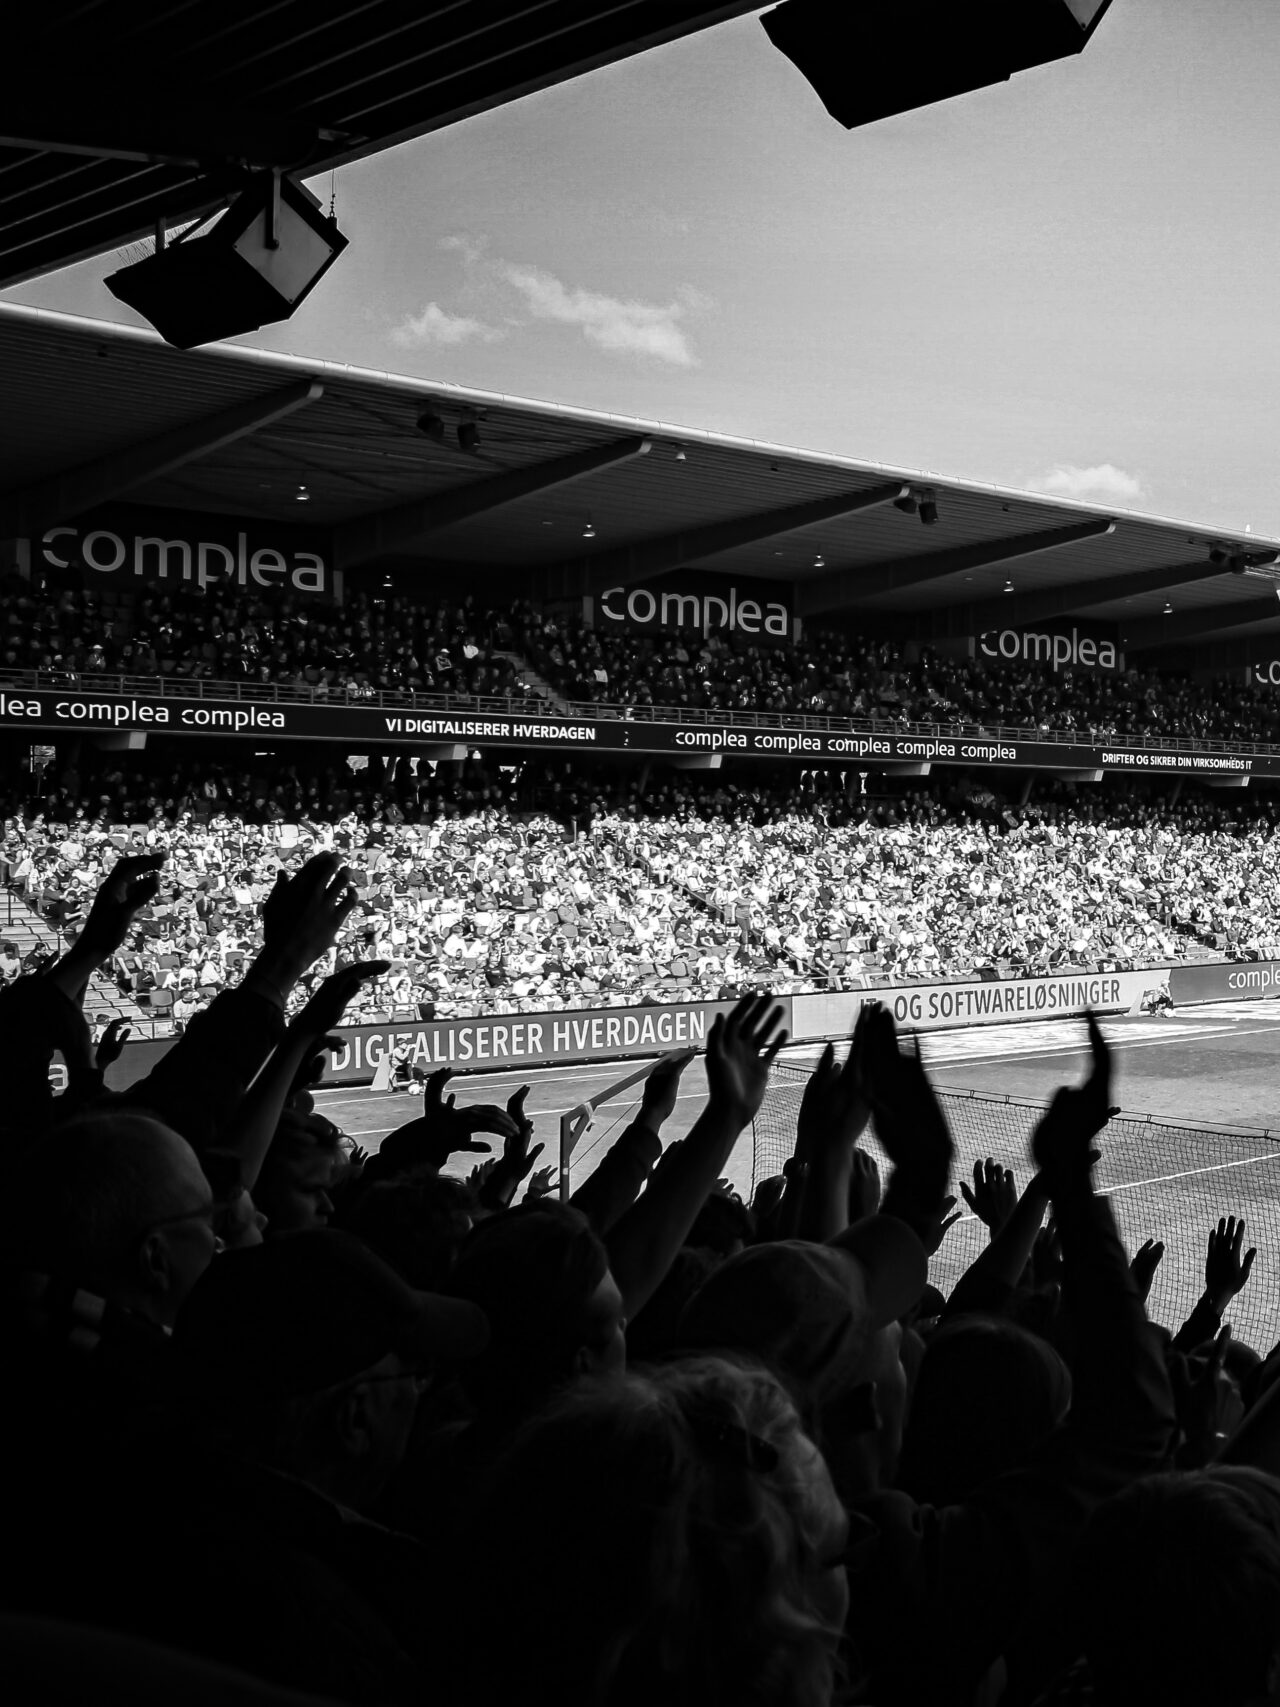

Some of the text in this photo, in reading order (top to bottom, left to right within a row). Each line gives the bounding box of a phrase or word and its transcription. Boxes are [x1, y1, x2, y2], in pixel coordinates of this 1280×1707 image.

[42, 528, 325, 593] complea
[601, 587, 788, 639] complea
[980, 627, 1116, 672] complea
[55, 700, 169, 726] complea
[181, 706, 286, 731] complea
[385, 718, 596, 740] VI DIGITALISERER HVERDAGEN
[675, 731, 1016, 761] complea complea complea complea complea
[1102, 753, 1253, 770] DRIFTER OG SIKRER DIN VIRKSOMHEDS IT
[894, 994, 922, 1021] OG
[929, 979, 1121, 1019] SOFTWARELØSNINGER
[553, 1010, 706, 1053] HVERDAGEN
